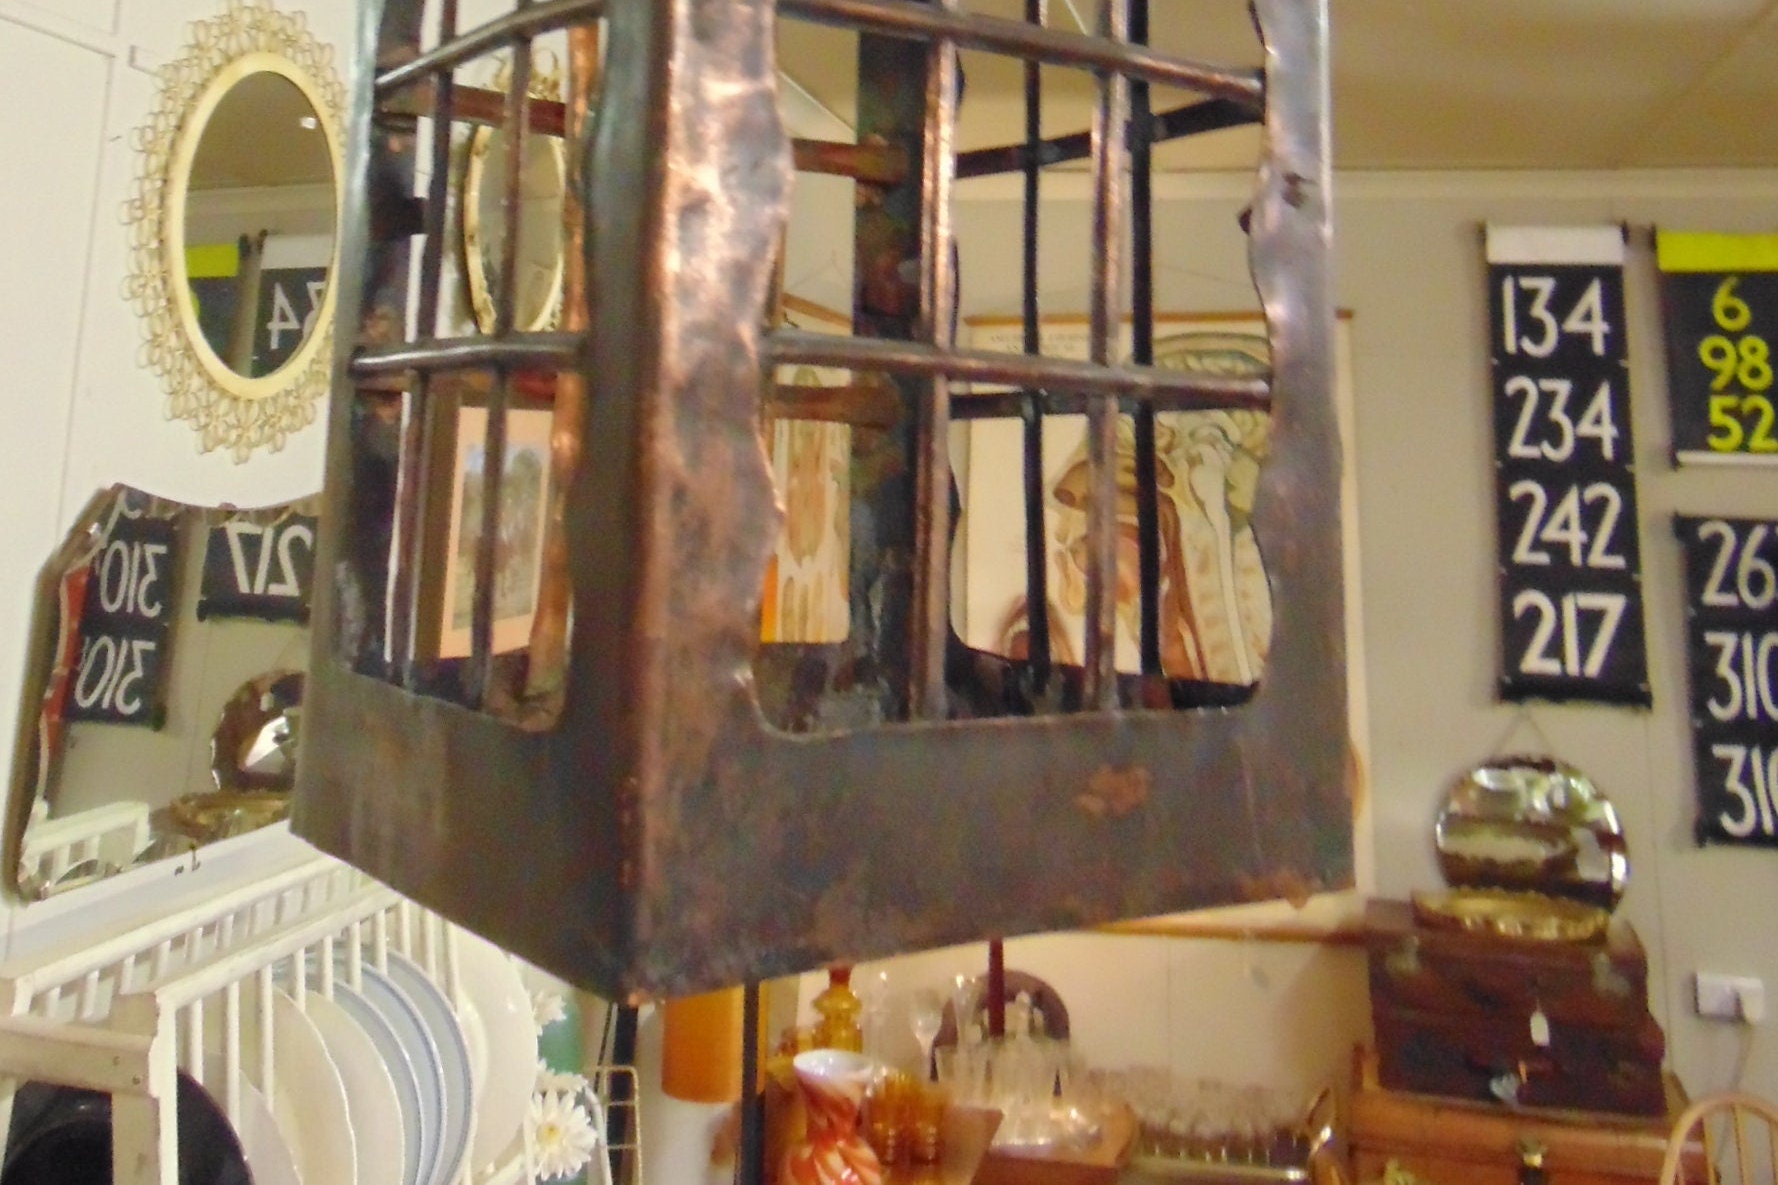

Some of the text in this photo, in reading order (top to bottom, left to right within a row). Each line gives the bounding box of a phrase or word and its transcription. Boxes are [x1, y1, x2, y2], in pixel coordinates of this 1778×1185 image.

[1503, 275, 1610, 358] 134
[1712, 276, 1751, 332] 6
[1698, 334, 1774, 391] 98
[1505, 376, 1619, 461] 234
[1707, 394, 1778, 453] 52
[1509, 480, 1625, 569] 242
[1699, 521, 1778, 609] 26
[1513, 589, 1626, 678] 217
